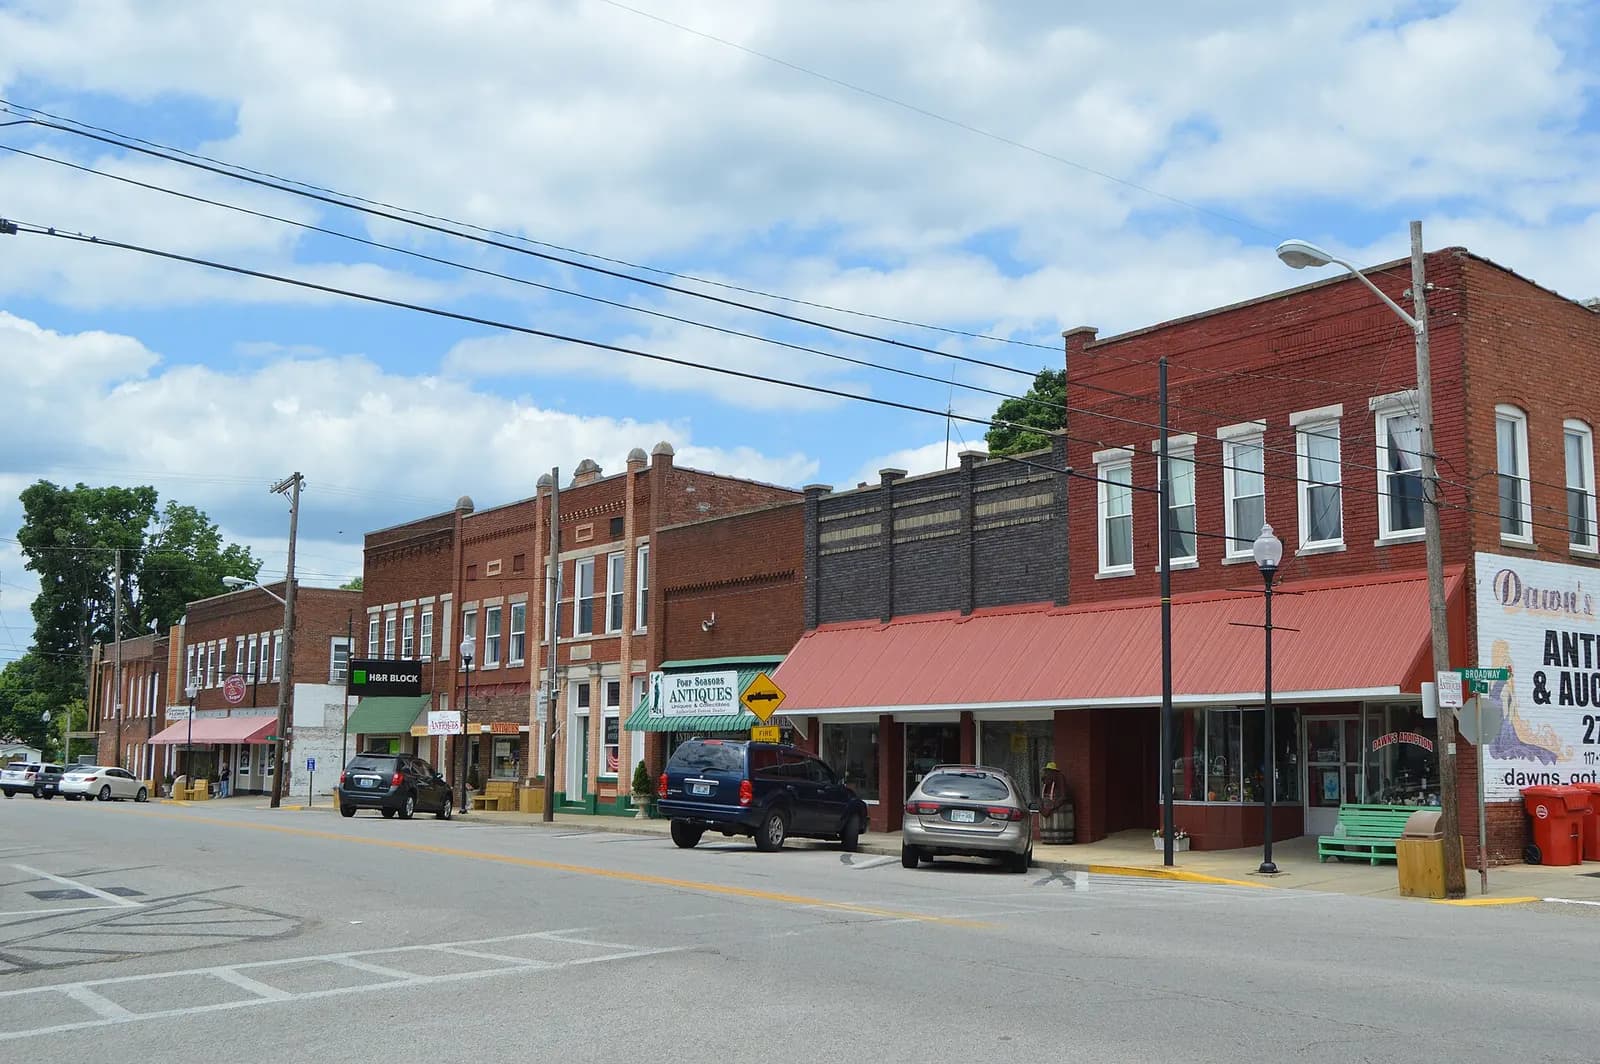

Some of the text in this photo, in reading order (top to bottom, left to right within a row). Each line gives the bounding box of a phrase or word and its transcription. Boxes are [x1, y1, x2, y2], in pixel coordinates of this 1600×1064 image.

[1493, 568, 1593, 616] Dawn's
[369, 673, 418, 683] H&R BLOCK
[676, 676, 725, 688] Four Seasons
[1465, 669, 1501, 679] BROADWAY
[669, 687, 733, 704] ANTIQUES
[1532, 670, 1552, 705] &
[1399, 732, 1434, 752] ADDICTION
